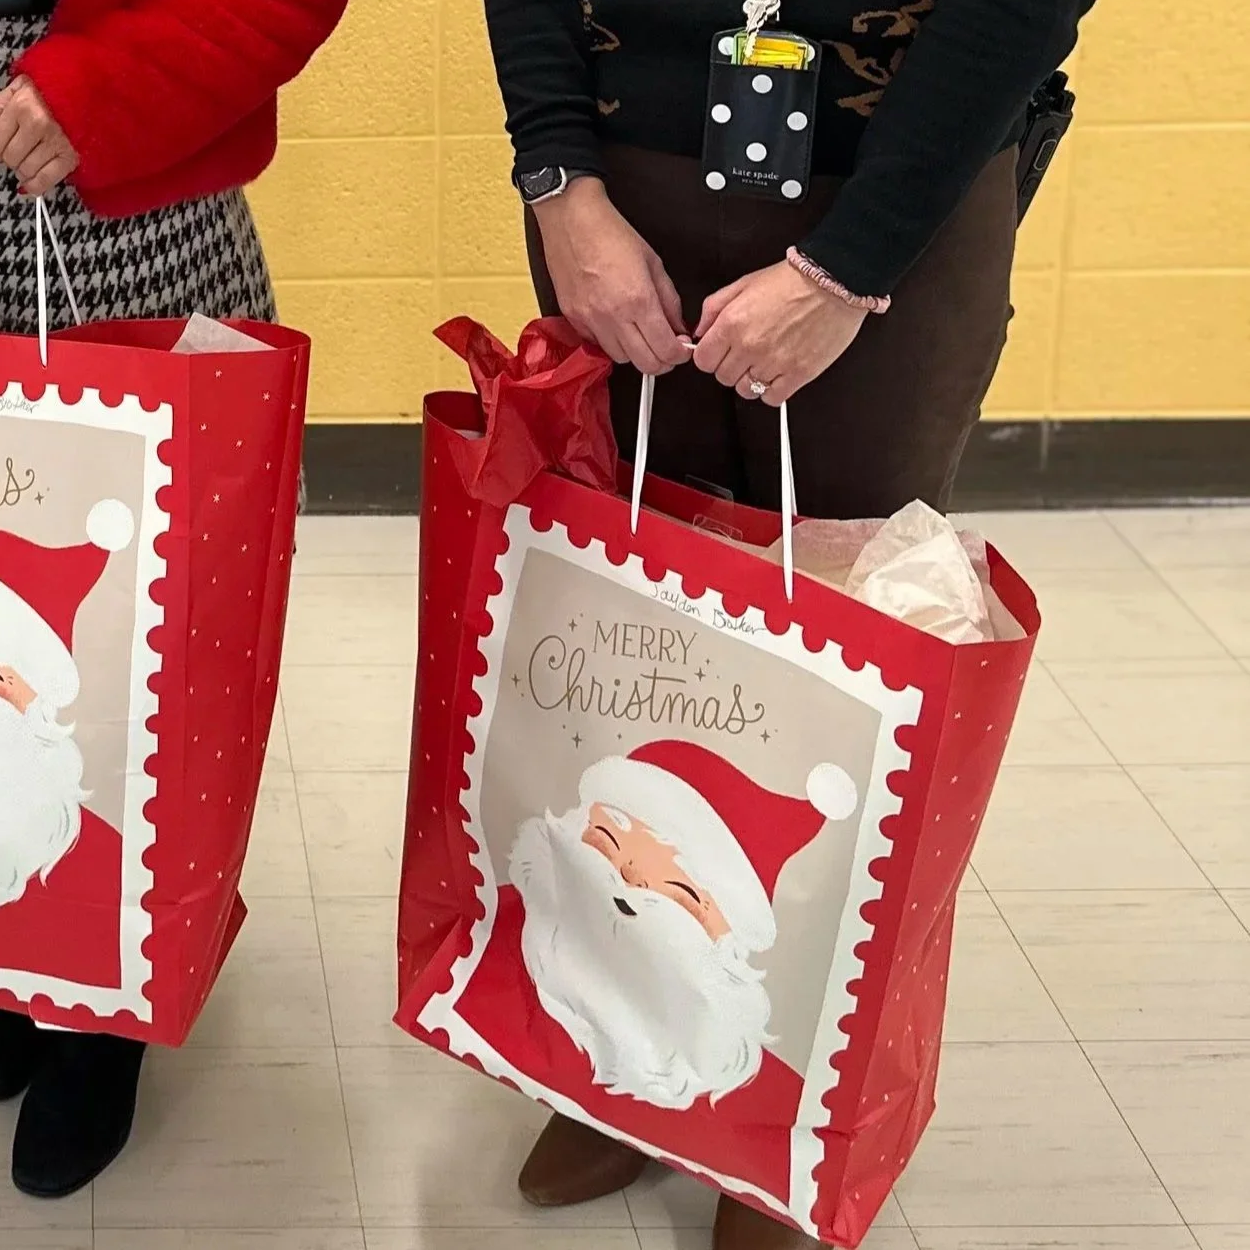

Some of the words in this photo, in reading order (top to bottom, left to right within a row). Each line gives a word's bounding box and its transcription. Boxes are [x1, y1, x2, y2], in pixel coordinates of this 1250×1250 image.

[732, 166, 752, 177] kate
[753, 171, 780, 180] spade
[592, 620, 698, 665] MERRY
[528, 634, 766, 735] Christmas
